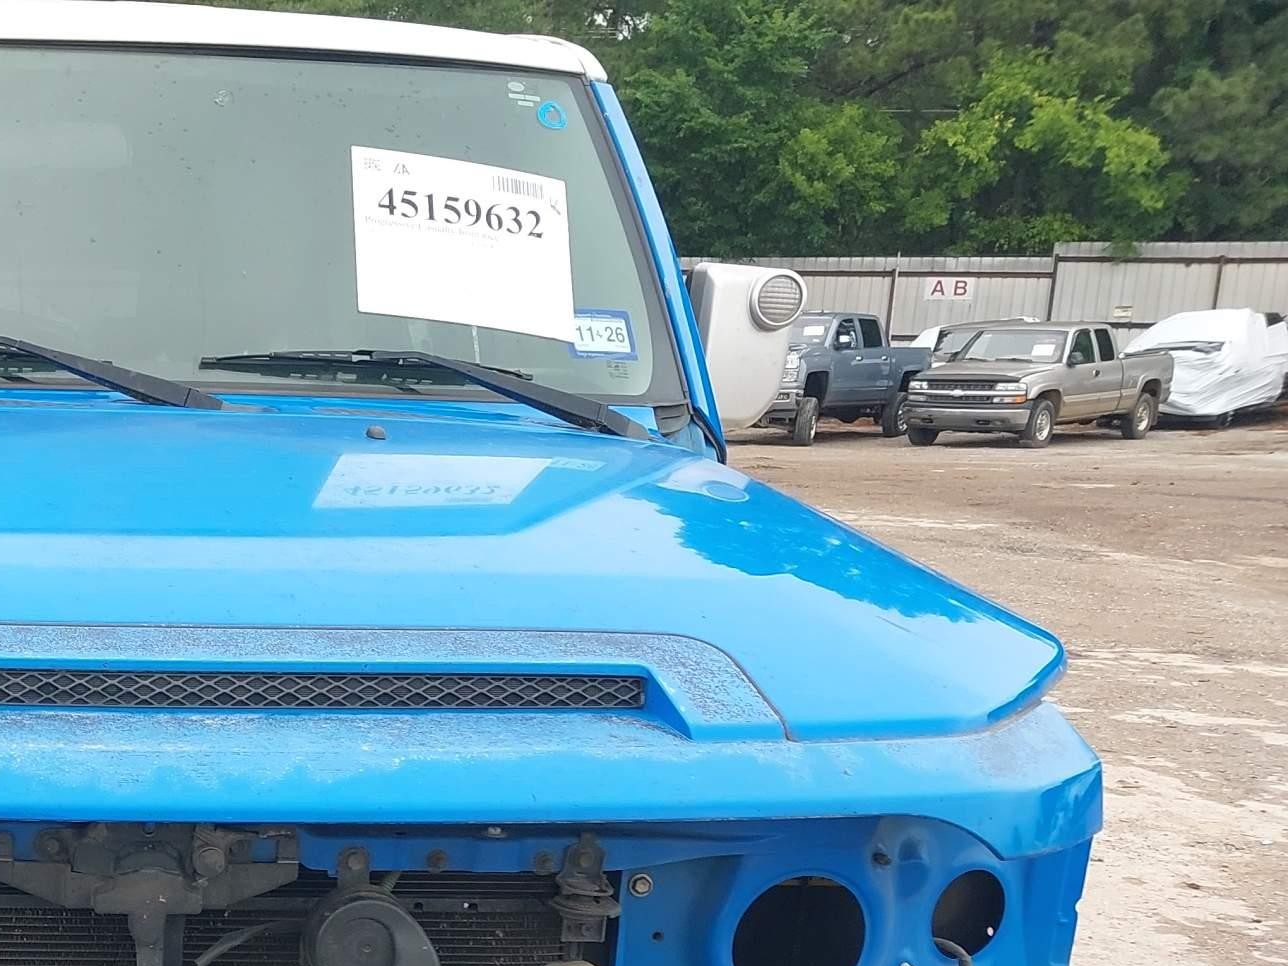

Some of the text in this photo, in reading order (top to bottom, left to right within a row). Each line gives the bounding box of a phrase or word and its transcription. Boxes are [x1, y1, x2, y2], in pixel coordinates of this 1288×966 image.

[377, 187, 544, 239] 45159632
[931, 280, 968, 296] A B
